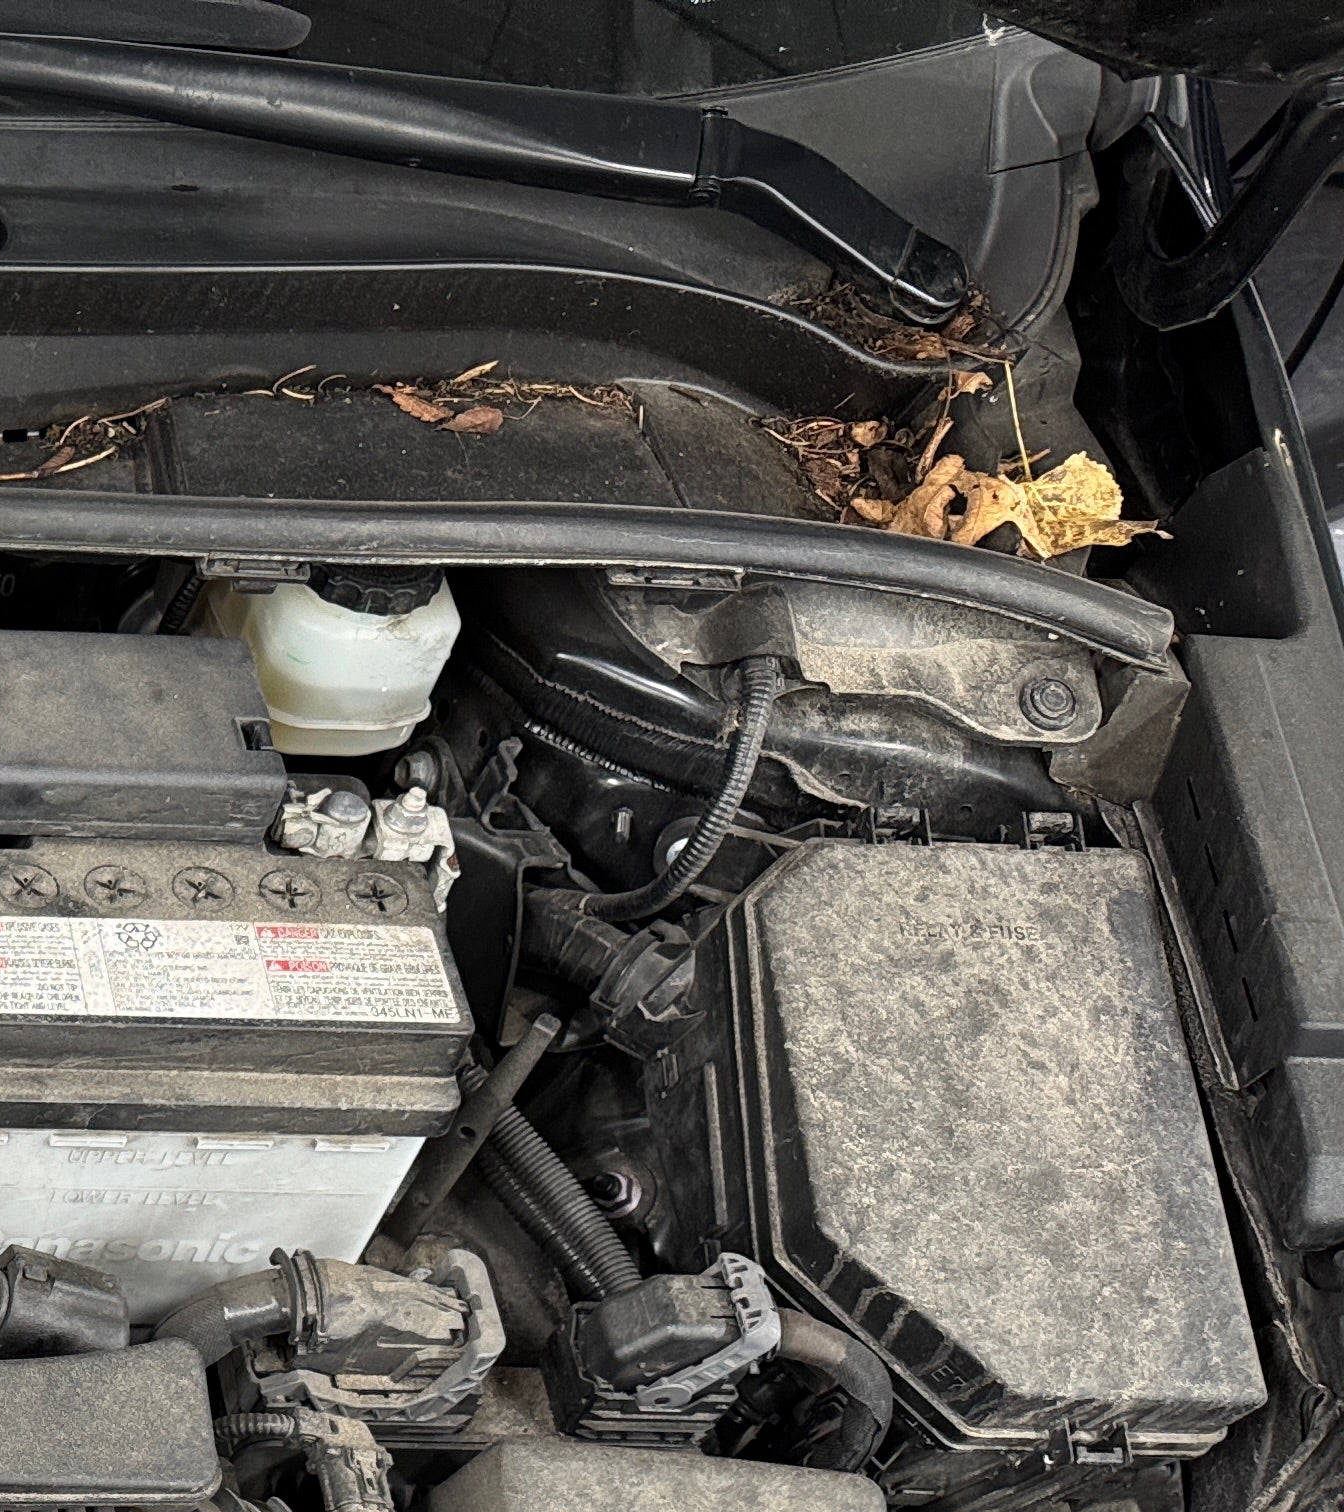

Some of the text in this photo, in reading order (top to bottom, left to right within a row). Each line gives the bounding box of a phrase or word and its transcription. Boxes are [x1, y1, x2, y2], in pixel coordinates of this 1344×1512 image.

[276, 927, 319, 939] DANGER
[288, 961, 330, 972] POISON
[68, 1149, 237, 1168] UPPER LEVEL
[49, 1189, 216, 1206] LOWER LEVEL
